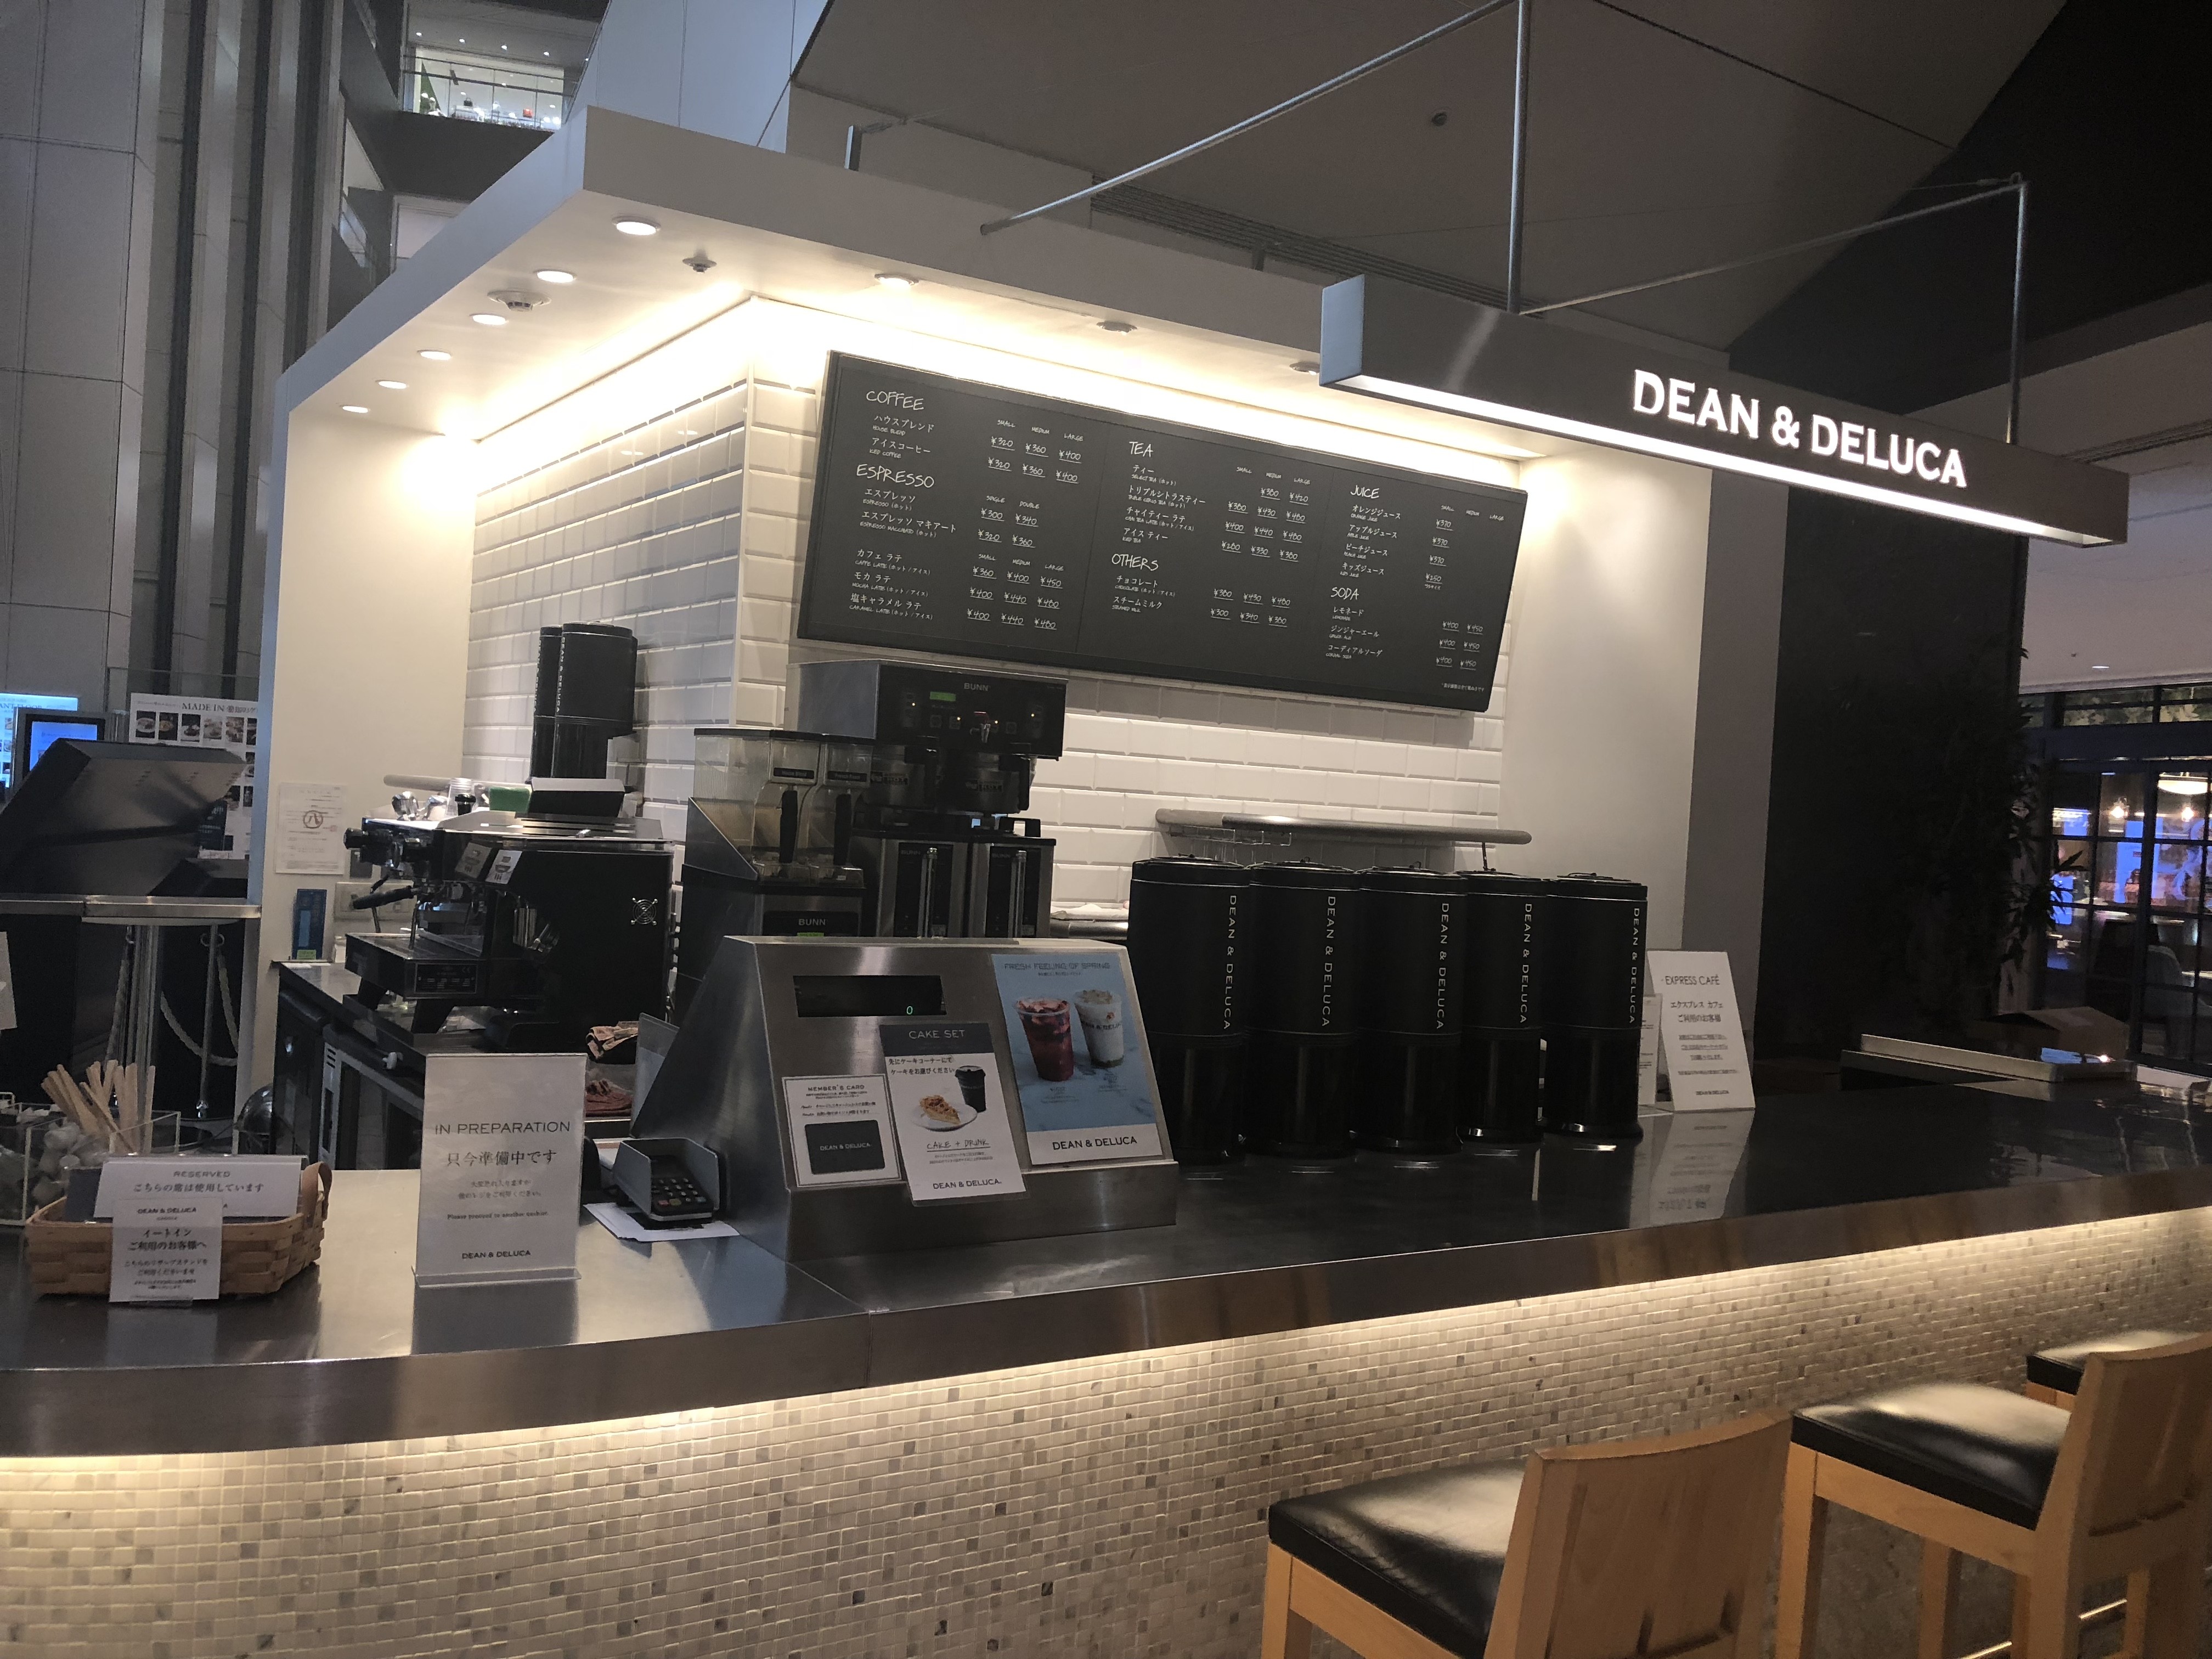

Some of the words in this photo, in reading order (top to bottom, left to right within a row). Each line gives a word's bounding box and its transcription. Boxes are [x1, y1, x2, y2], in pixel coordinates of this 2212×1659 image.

[866, 391, 924, 410] COFFEE
[874, 415, 934, 433] ハウスブレンド
[997, 419, 1015, 428] SMALL
[1064, 433, 1084, 441] LARGE
[1633, 369, 1759, 438] DEAN
[1771, 405, 1799, 448] &
[1811, 414, 1967, 488] DELUCA
[872, 437, 931, 453] アイスコーヒー
[991, 436, 1014, 447] ¥320
[1025, 443, 1047, 454] ¥360
[1059, 450, 1081, 460] ¥400
[1129, 442, 1153, 457] TEA
[856, 464, 935, 488] ESPRESSO
[988, 457, 1010, 469] ¥320
[1022, 464, 1043, 475] ¥360
[1056, 470, 1077, 482] ¥400
[1133, 465, 1154, 474] ティー
[865, 489, 916, 503] エスプレッソ
[1130, 485, 1206, 505] トリプルシトラスティー
[1289, 493, 1308, 502] ¥420
[1350, 485, 1380, 499] JUICE
[1019, 501, 1040, 509] DOUBLE
[1257, 506, 1276, 516] ¥430
[981, 507, 1003, 520] ¥300
[1015, 514, 1037, 525] ¥340
[1126, 507, 1169, 519] チャイティー
[1173, 514, 1185, 523] ラテ
[1352, 505, 1400, 520] オレンジジュース
[862, 511, 912, 526] エスプレッソ
[916, 520, 956, 533] マキアート
[1225, 521, 1244, 531] ¥400
[1254, 526, 1273, 536] ¥440
[1436, 519, 1451, 528] ¥370
[978, 529, 1000, 541] ¥320
[1012, 534, 1032, 546] ¥360
[1124, 528, 1144, 537] アイス
[1148, 531, 1168, 540] ティー
[1350, 524, 1397, 538] アップルジュース
[1432, 537, 1448, 546] ¥370
[857, 549, 882, 559] カフェ
[887, 554, 902, 563] ラテ
[1346, 543, 1387, 556] ピーチジュース
[1112, 554, 1159, 571] OTHERS
[1430, 555, 1444, 564] ¥370
[1342, 562, 1384, 575] キッズジュース
[854, 572, 870, 581] モカ
[875, 574, 891, 583] ラテ
[973, 566, 994, 577] ¥360
[1007, 572, 1029, 582] ¥400
[1040, 576, 1062, 587] ¥450
[1117, 575, 1158, 588] チョコレート
[1426, 573, 1442, 582] ¥250
[970, 587, 992, 599] ¥400
[1004, 592, 1027, 603] ¥440
[1037, 597, 1059, 608] ¥480
[1243, 593, 1262, 602] ¥430
[1330, 587, 1359, 600] SODA
[850, 593, 902, 607] 塩キャラメル
[906, 601, 922, 610] ラテ
[1113, 596, 1162, 609] スチームミルク
[1211, 608, 1228, 617] ¥300
[1240, 612, 1258, 621] ¥340
[1268, 616, 1286, 624] ¥380
[1333, 606, 1364, 616] レモネード
[967, 608, 990, 620] ¥400
[1001, 613, 1024, 625] ¥440
[1034, 618, 1056, 629] ¥480
[1331, 625, 1380, 637] ジンジャーエール
[1442, 620, 1459, 629] ¥400
[1467, 624, 1483, 633] ¥450
[1328, 645, 1383, 657] コーディアルソーダ
[1464, 641, 1480, 650] ¥450
[964, 682, 988, 691] BUNN
[182, 702, 211, 712] MADE
[213, 704, 224, 712] IN
[1228, 895, 1237, 939] DEAN
[1327, 896, 1336, 939] DEAN
[1440, 903, 1449, 944] DEAN
[1523, 904, 1532, 943] DEAN
[1227, 946, 1234, 956] &
[1325, 946, 1333, 955] &
[1440, 951, 1447, 960] &
[1523, 949, 1530, 958] &
[1632, 952, 1638, 961] &
[1665, 976, 1697, 985] EXPRESS
[1699, 974, 1720, 985] CAFÉ
[1224, 963, 1233, 1029] DELUCA
[1322, 962, 1333, 1026] DELUCA
[1436, 967, 1446, 1029] DELUCA
[1520, 964, 1529, 1023] DELUCA
[906, 1006, 913, 1015] 0
[909, 1030, 940, 1039] CAKE
[944, 1030, 965, 1038] SET
[435, 1125, 450, 1135] IN
[458, 1121, 570, 1134] PREPARATION
[927, 1141, 951, 1149] CAKE
[964, 1139, 989, 1147] DRINK
[1053, 1140, 1082, 1150] DEAN
[1095, 1136, 1137, 1147] DELUCA
[447, 1149, 557, 1167] 只今準備中です
[134, 1183, 263, 1193] こちらの席は使用しています
[966, 1178, 1000, 1187] DELUCA
[144, 1228, 191, 1238] イートイン
